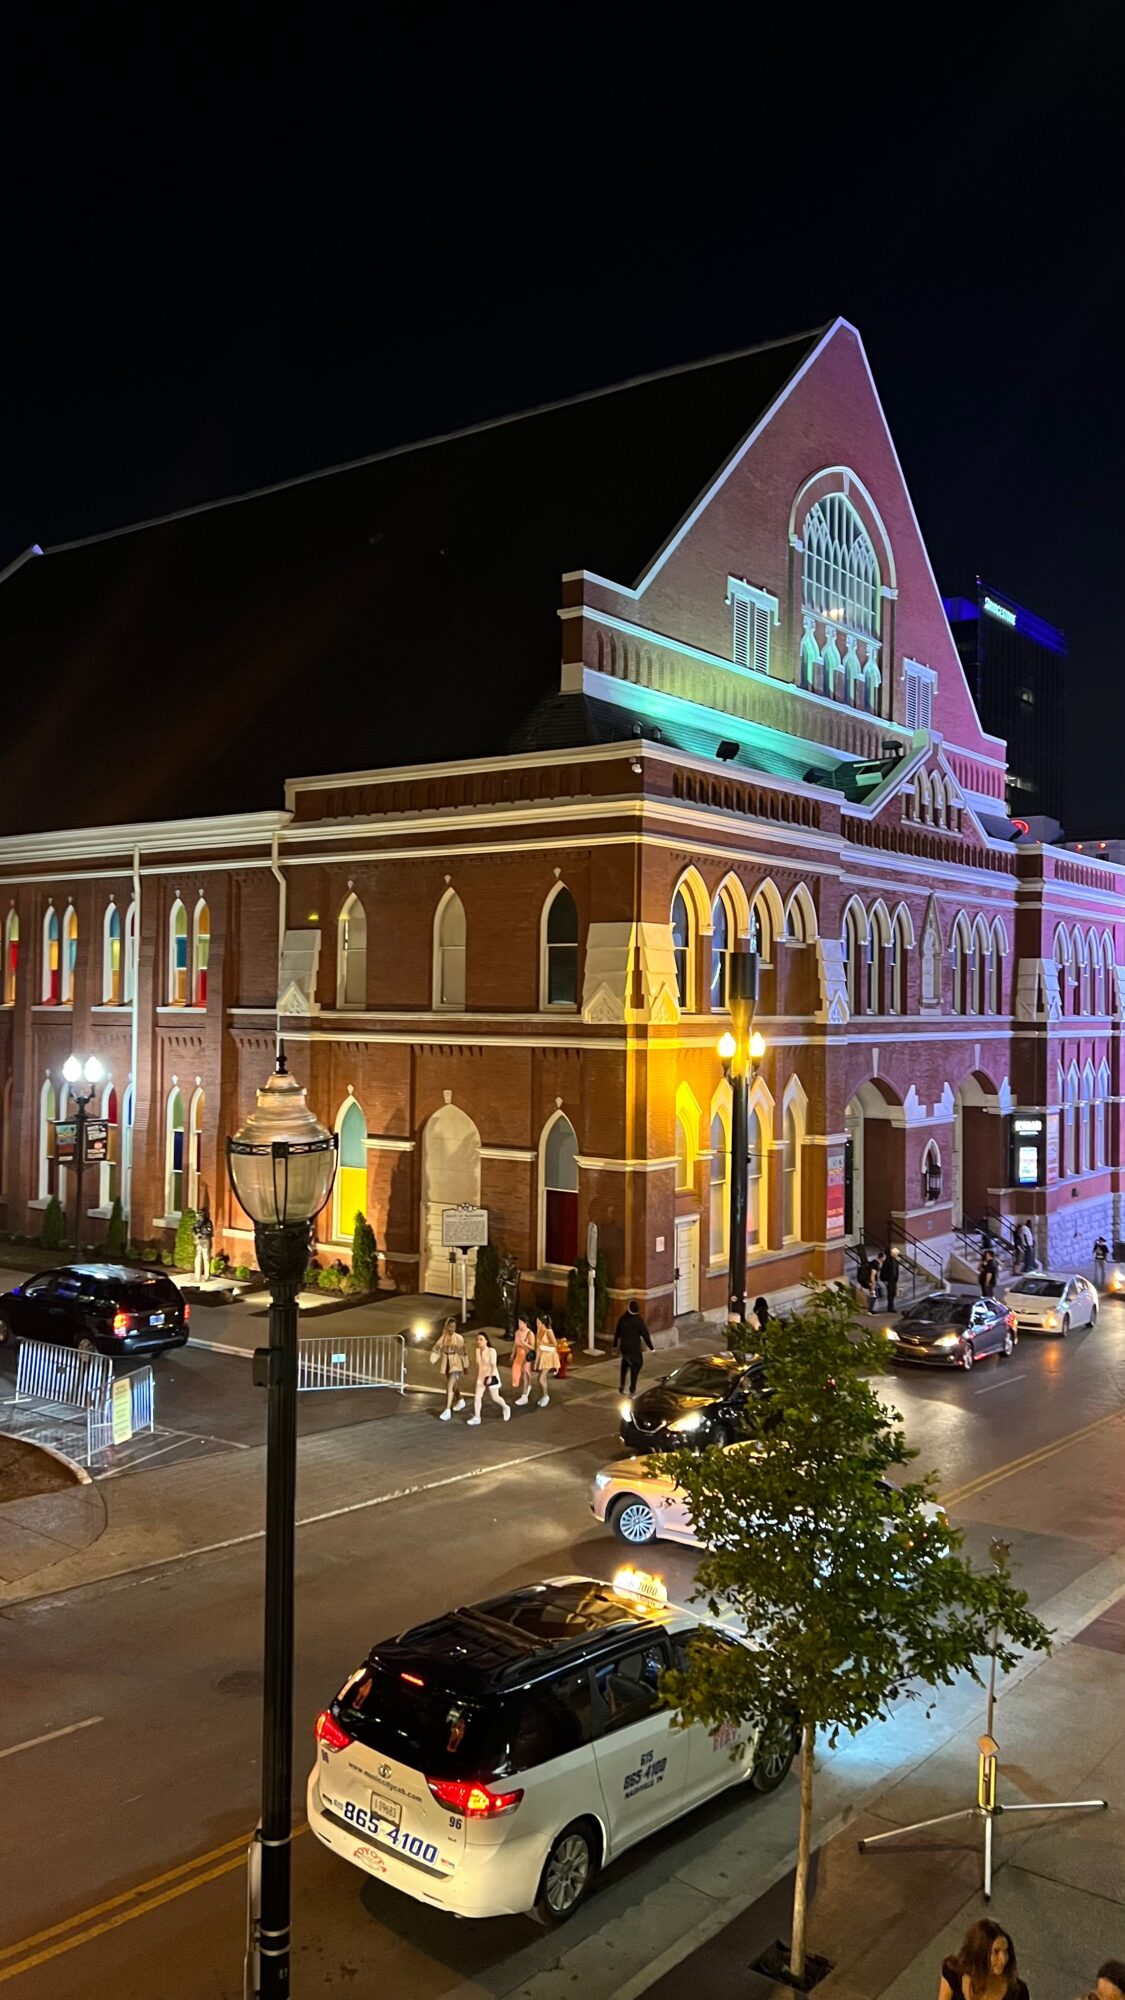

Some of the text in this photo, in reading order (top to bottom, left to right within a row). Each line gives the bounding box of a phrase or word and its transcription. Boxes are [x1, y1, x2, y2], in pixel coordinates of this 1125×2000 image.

[343, 1801, 438, 1863] 865 4100
[449, 1816, 462, 1830] 96
